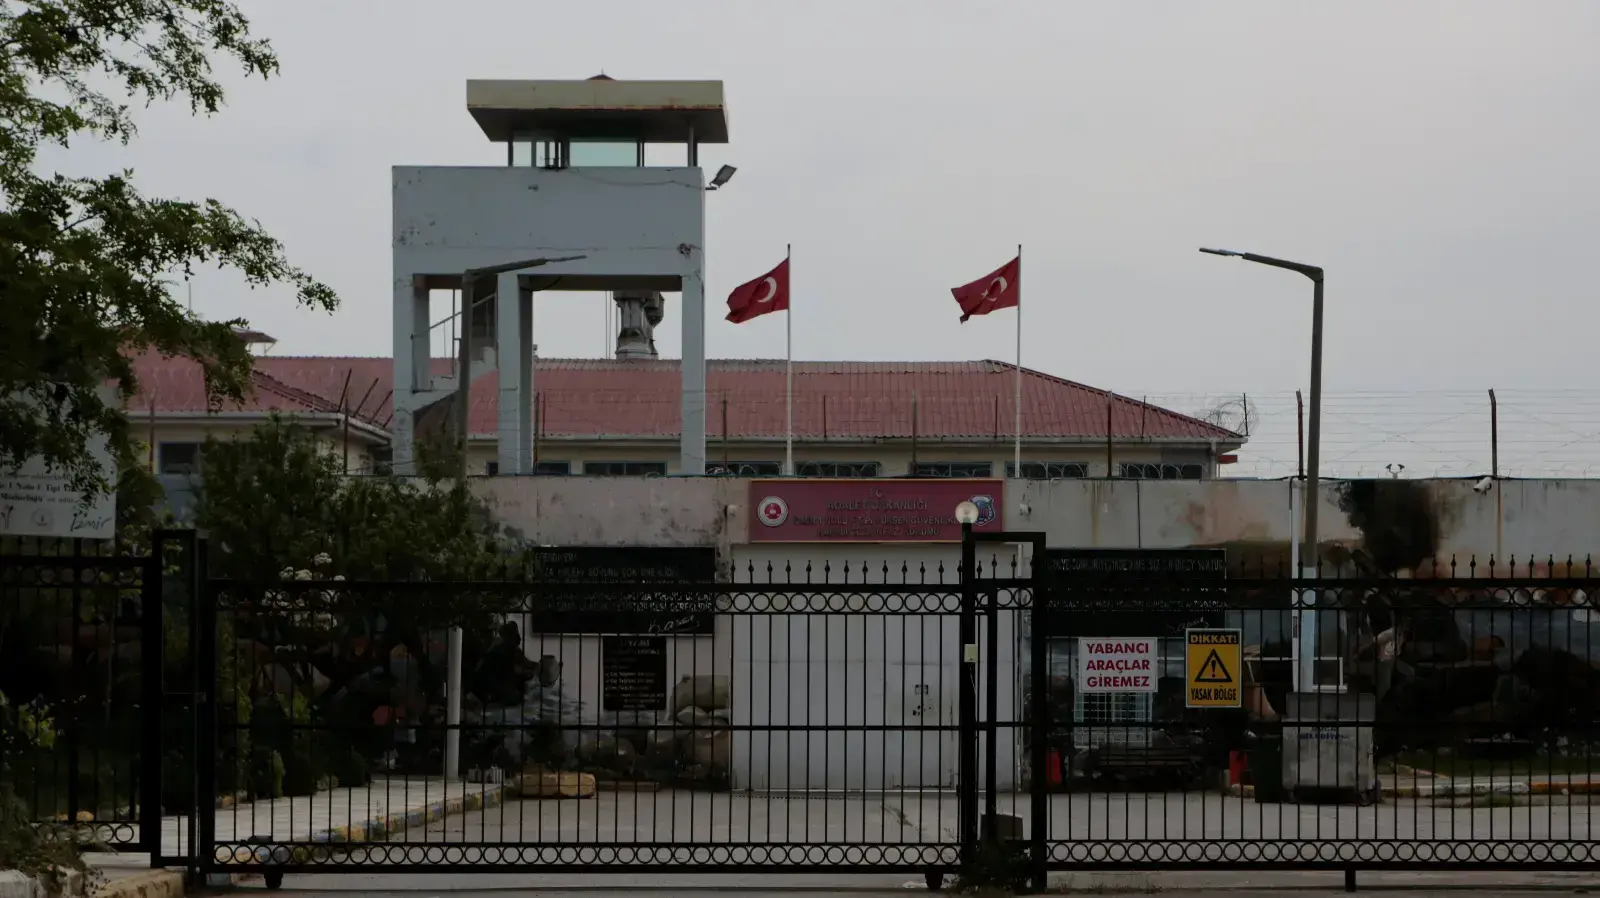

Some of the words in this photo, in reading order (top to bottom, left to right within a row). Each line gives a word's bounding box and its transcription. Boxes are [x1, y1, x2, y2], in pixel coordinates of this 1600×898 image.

[1190, 631, 1237, 643] DİKKAT!
[1087, 643, 1149, 654] YABANCI
[1086, 659, 1150, 673] ARAÇLAR
[1087, 674, 1150, 687] GİREMEZ
[1190, 688, 1212, 701] YASAK
[1214, 685, 1237, 701] BÖLGE
